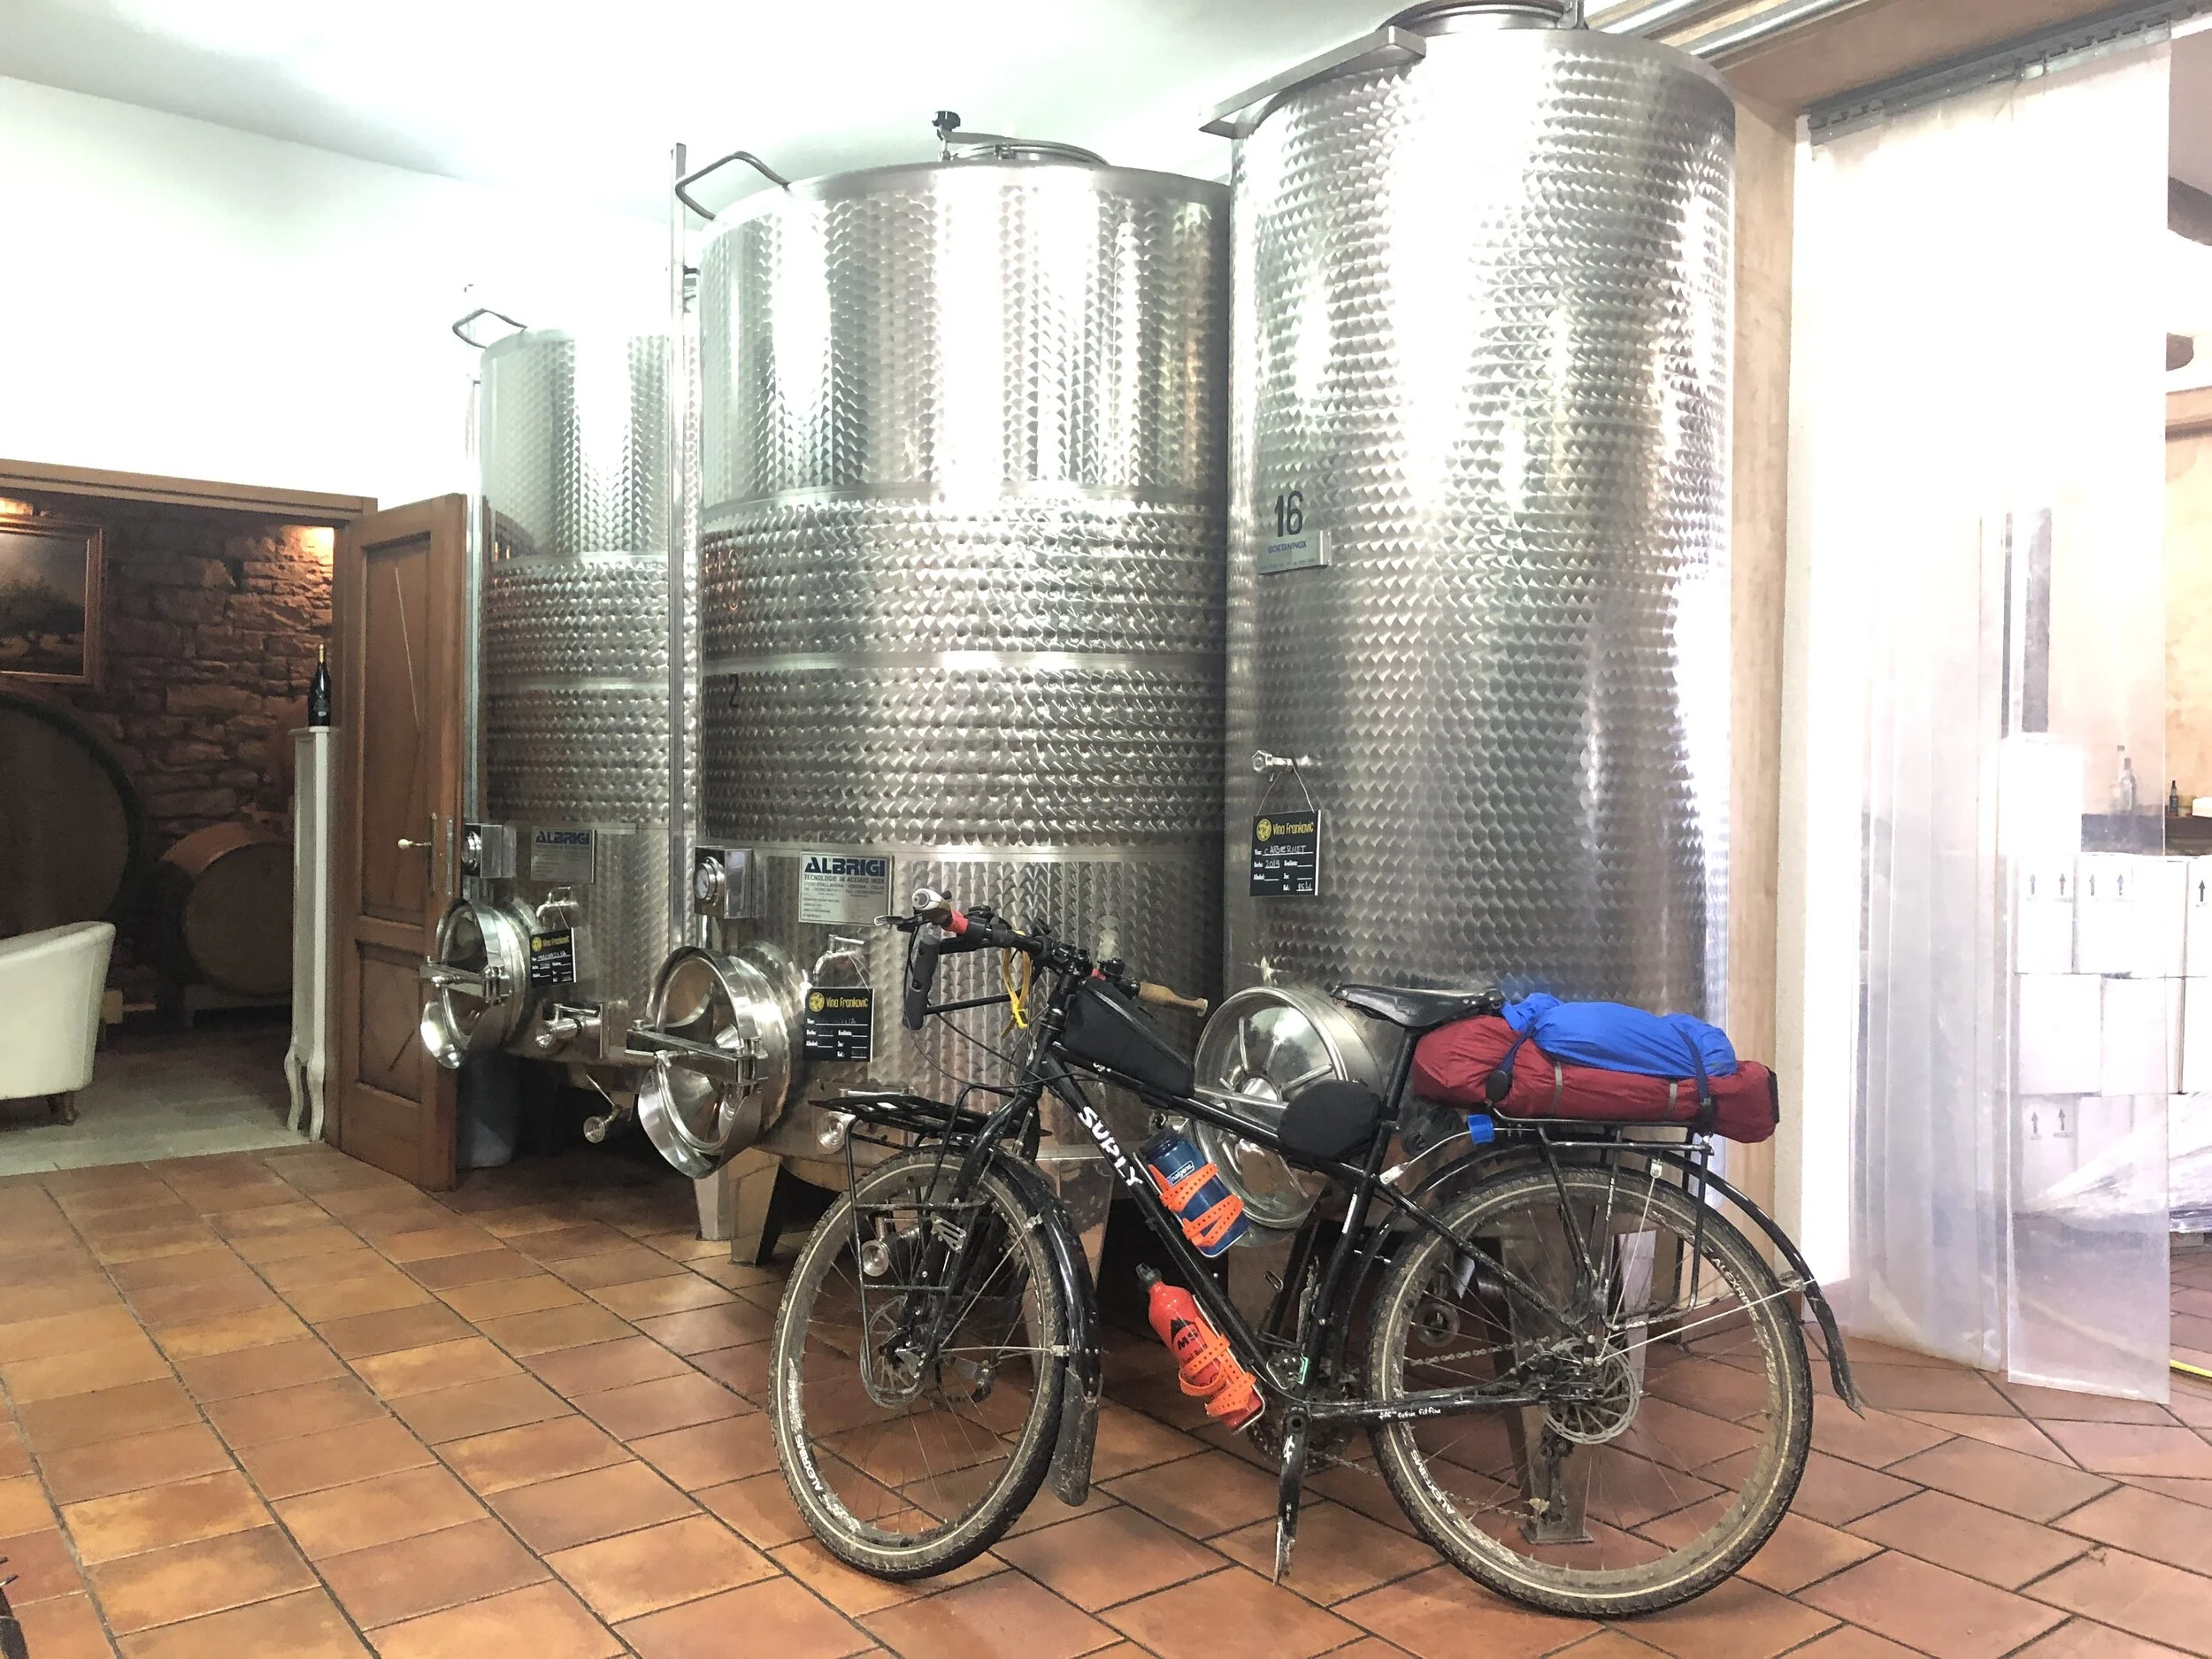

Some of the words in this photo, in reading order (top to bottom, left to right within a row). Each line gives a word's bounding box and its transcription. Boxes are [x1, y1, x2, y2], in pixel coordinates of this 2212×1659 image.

[1274, 490, 1303, 537] 16
[728, 673, 739, 708] 2
[536, 831, 590, 844] ALBRIGI
[804, 857, 885, 877] ALBRIGI
[1078, 1106, 1143, 1187] SURLY
[795, 1433, 824, 1491] ALEXRIMS
[1410, 1449, 1455, 1515] ALEXRIMS
